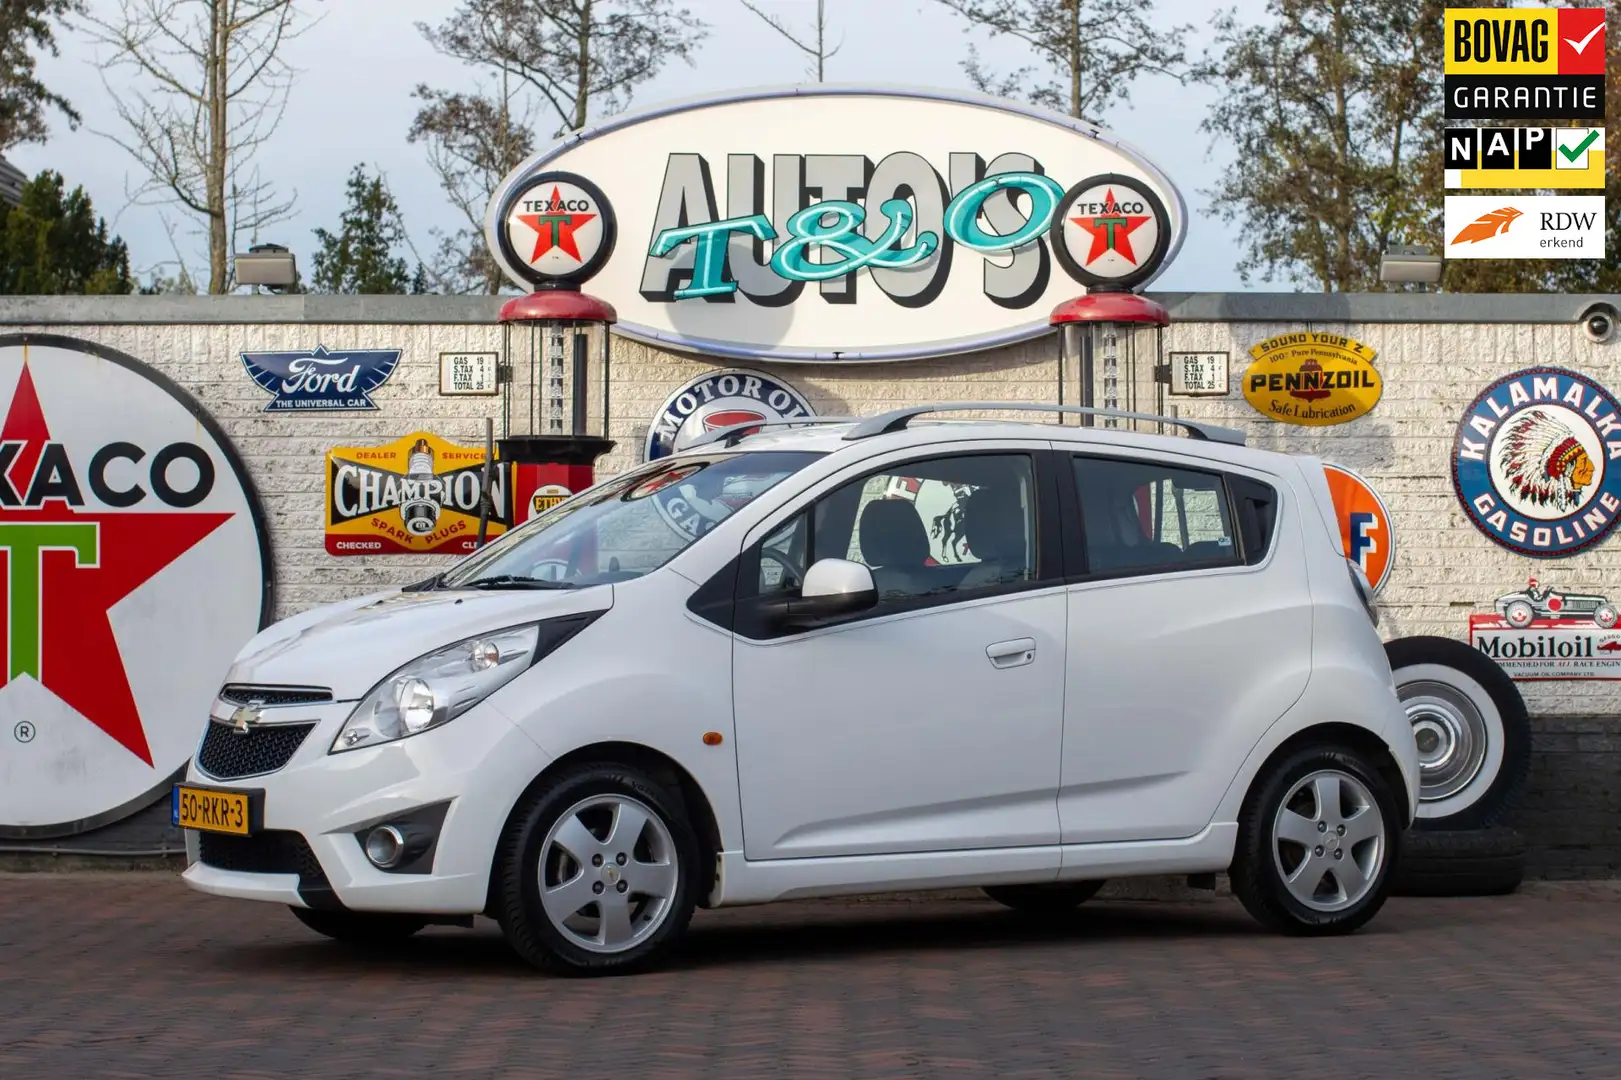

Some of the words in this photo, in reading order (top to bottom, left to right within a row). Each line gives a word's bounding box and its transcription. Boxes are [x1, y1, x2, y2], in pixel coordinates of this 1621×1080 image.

[523, 200, 589, 212] TEXACO
[1078, 202, 1144, 215] TEXACO
[639, 151, 1050, 310] AUTO'S
[1261, 334, 1307, 352] SOUND
[1311, 334, 1348, 347] YOUR
[1353, 343, 1364, 353] Z
[453, 356, 468, 365] GAS
[1183, 356, 1198, 364] GAS
[1291, 349, 1309, 358] Pure
[1310, 348, 1358, 365] Pennsylvania
[453, 365, 473, 373] S.TAX
[1184, 364, 1204, 372] S.TAX
[281, 357, 361, 394] Ford
[453, 373, 472, 382] F.TAX
[1184, 373, 1204, 381] F.TAX
[1250, 370, 1375, 393] PENNZOIL
[453, 382, 474, 390] TOTAL
[476, 382, 484, 390] 25
[1184, 381, 1205, 390] TOTAL
[1207, 381, 1215, 390] 25
[276, 400, 293, 408] THE
[294, 400, 344, 408] UNIVERSAL
[347, 399, 366, 407] CAR
[660, 375, 762, 440] MOTOR
[768, 389, 804, 418] OI
[1269, 399, 1293, 416] Safe
[1294, 404, 1356, 419] Lubrication
[356, 452, 397, 460] DEALER
[442, 452, 486, 460] SERVICE
[334, 462, 505, 519] CHAMPION
[1473, 492, 1621, 547] GASOLINE
[371, 517, 414, 544] SPARK
[425, 520, 467, 544] PLUGS
[336, 541, 382, 550] CHECKED
[1477, 635, 1593, 658] Mobiloil
[182, 793, 244, 828] 50-RKR-3
